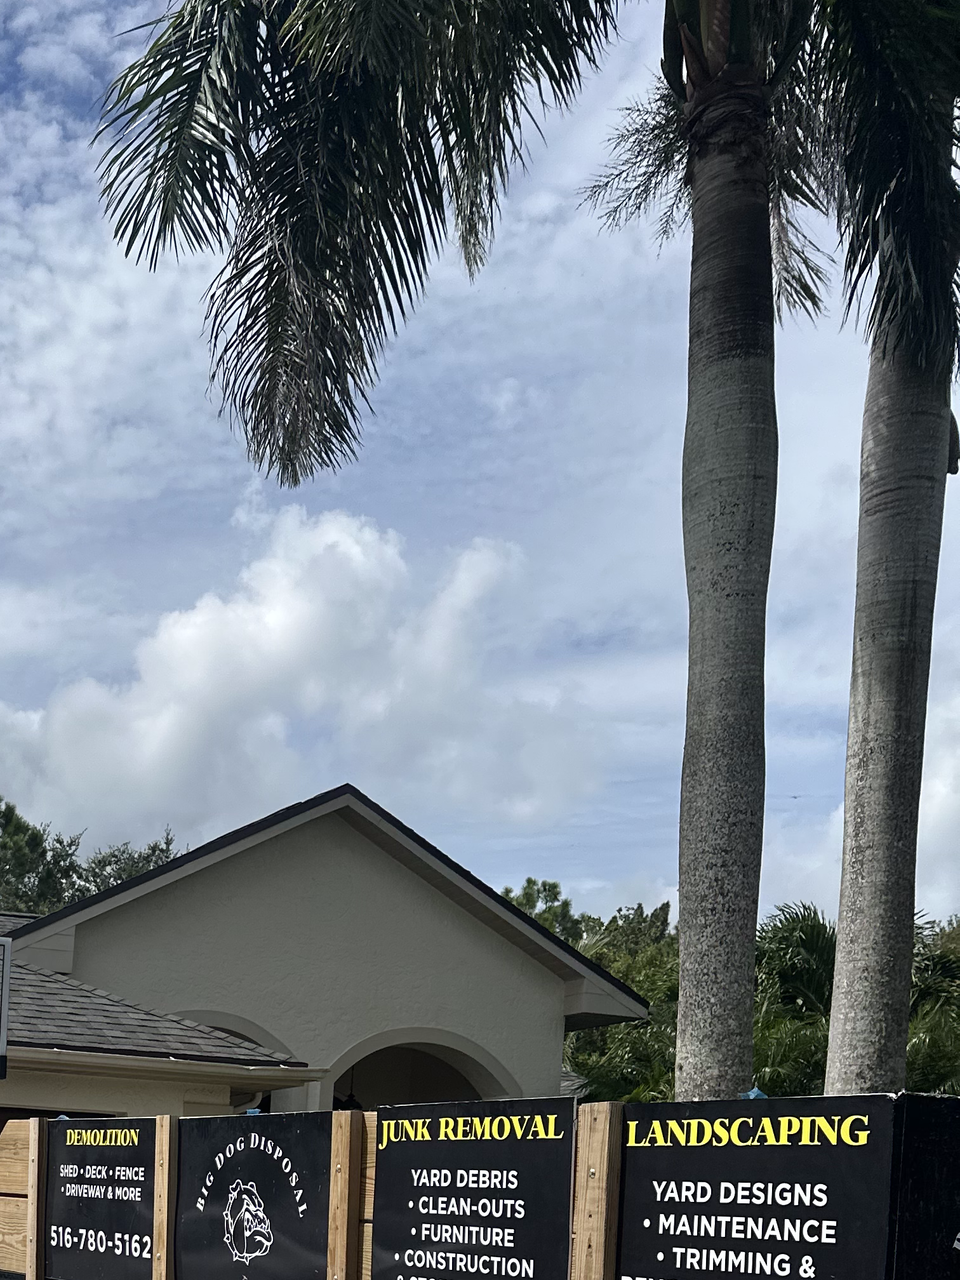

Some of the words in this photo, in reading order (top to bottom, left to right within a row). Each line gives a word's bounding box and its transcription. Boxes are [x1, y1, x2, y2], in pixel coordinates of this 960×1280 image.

[65, 1129, 140, 1146] DEMOLITION
[378, 1118, 432, 1150] JUNK
[438, 1114, 565, 1141] REMOVAL
[626, 1115, 870, 1147] LANDSCAPING
[60, 1164, 79, 1178] SHED
[85, 1165, 108, 1179] DECK
[115, 1167, 145, 1181] FENCE
[196, 1171, 214, 1212] BIG
[214, 1136, 245, 1170] DOG
[250, 1132, 308, 1218] DISPOSAL
[411, 1169, 452, 1187] YARD
[456, 1170, 518, 1189] DEBRIS
[65, 1183, 106, 1199] DRIVEWAY
[107, 1186, 113, 1199] &
[115, 1187, 142, 1201] MORE
[652, 1180, 712, 1203] YARD
[719, 1182, 828, 1207] DESIGNS
[418, 1196, 525, 1219] CLEAN-OUTS
[50, 1225, 152, 1259] 516-780-5162
[421, 1224, 515, 1247] FURNITURE
[658, 1213, 837, 1244] MAINTENANCE
[404, 1249, 535, 1279] CONSTRUCTION
[672, 1247, 791, 1277] TRIMMING
[798, 1255, 817, 1279] &
